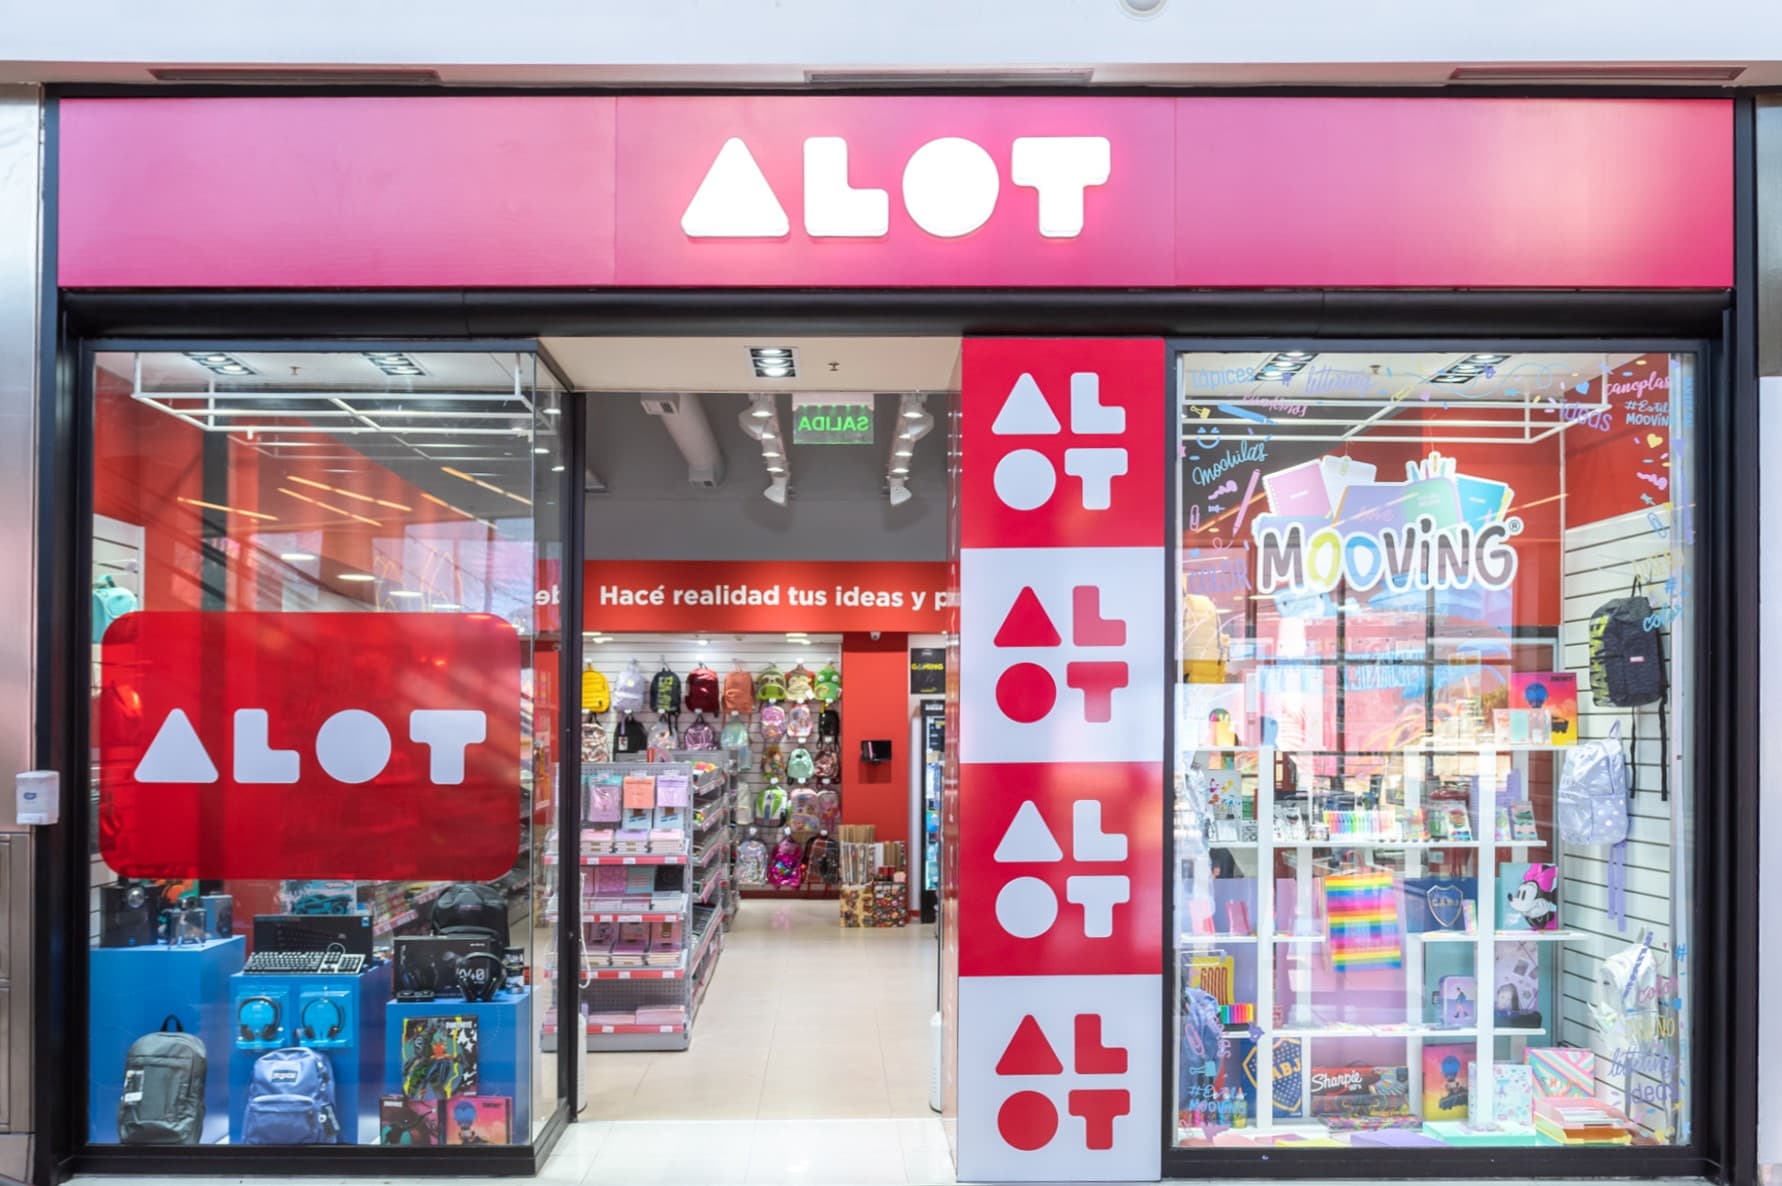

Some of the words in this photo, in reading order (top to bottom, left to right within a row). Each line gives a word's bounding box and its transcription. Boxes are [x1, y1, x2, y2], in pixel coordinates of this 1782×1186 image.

[681, 136, 1111, 238] ALOT
[600, 585, 664, 605] Hacé
[673, 585, 780, 606] realidad
[788, 586, 827, 606] tus
[835, 586, 904, 607] ideas
[911, 591, 926, 610] y
[134, 708, 487, 784] ALOT
[1271, 1057, 1302, 1082] ABJ
[1311, 1069, 1363, 1092] Sharpie
